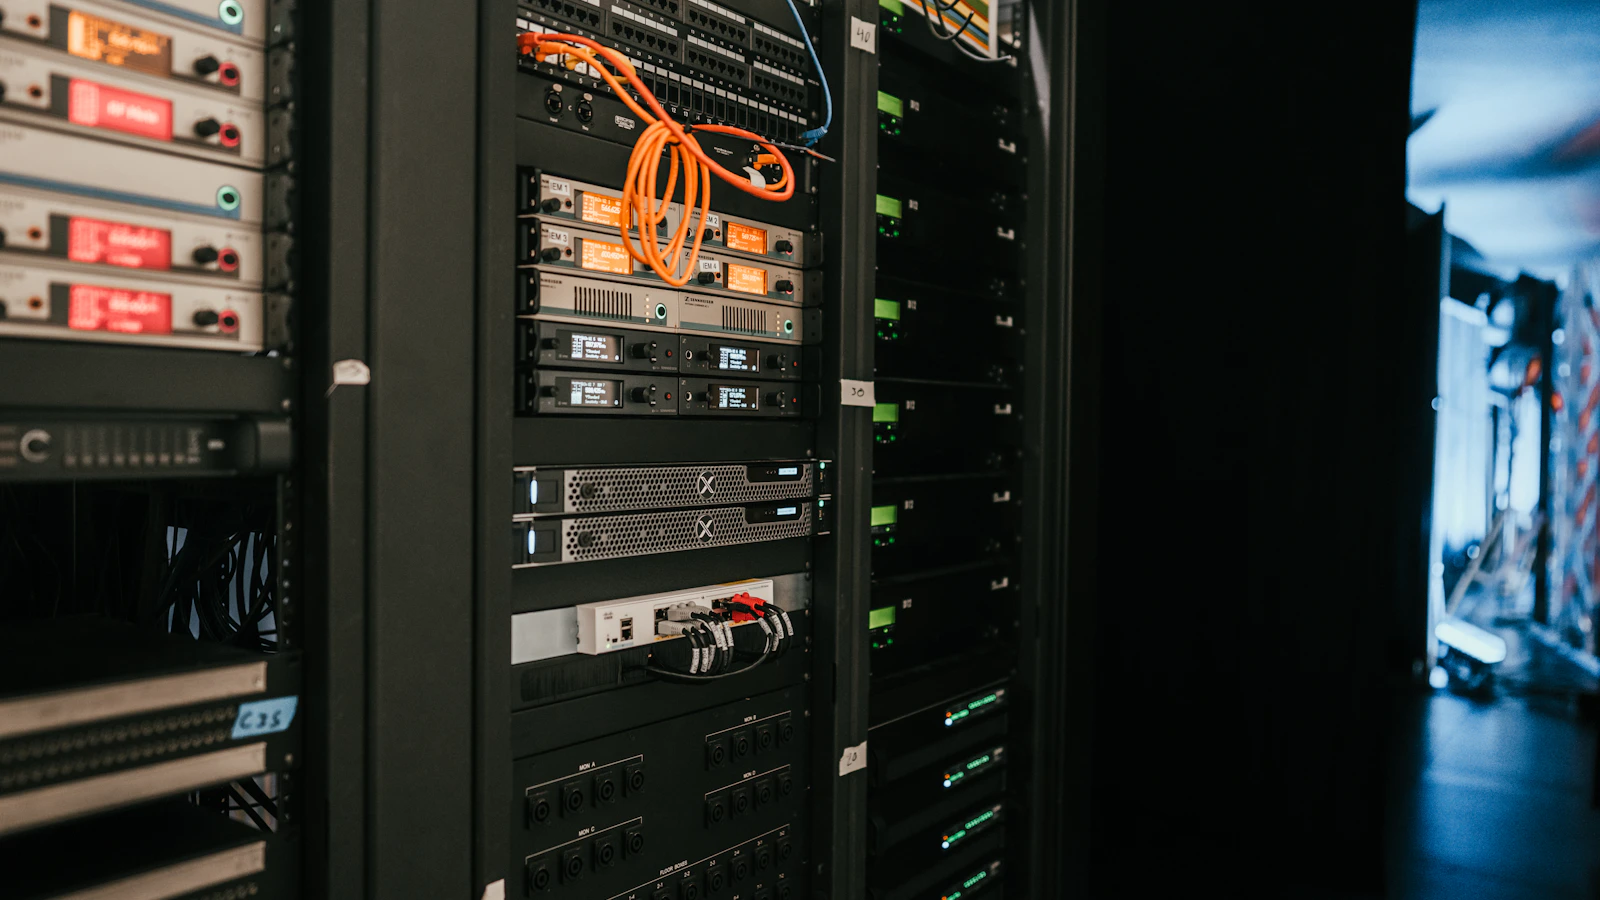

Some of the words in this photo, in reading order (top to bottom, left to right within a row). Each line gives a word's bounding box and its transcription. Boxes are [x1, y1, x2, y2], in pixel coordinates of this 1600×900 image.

[856, 26, 870, 43] 40
[851, 386, 865, 398] 30
[578, 763, 590, 771] MON
[578, 828, 590, 836] MON
